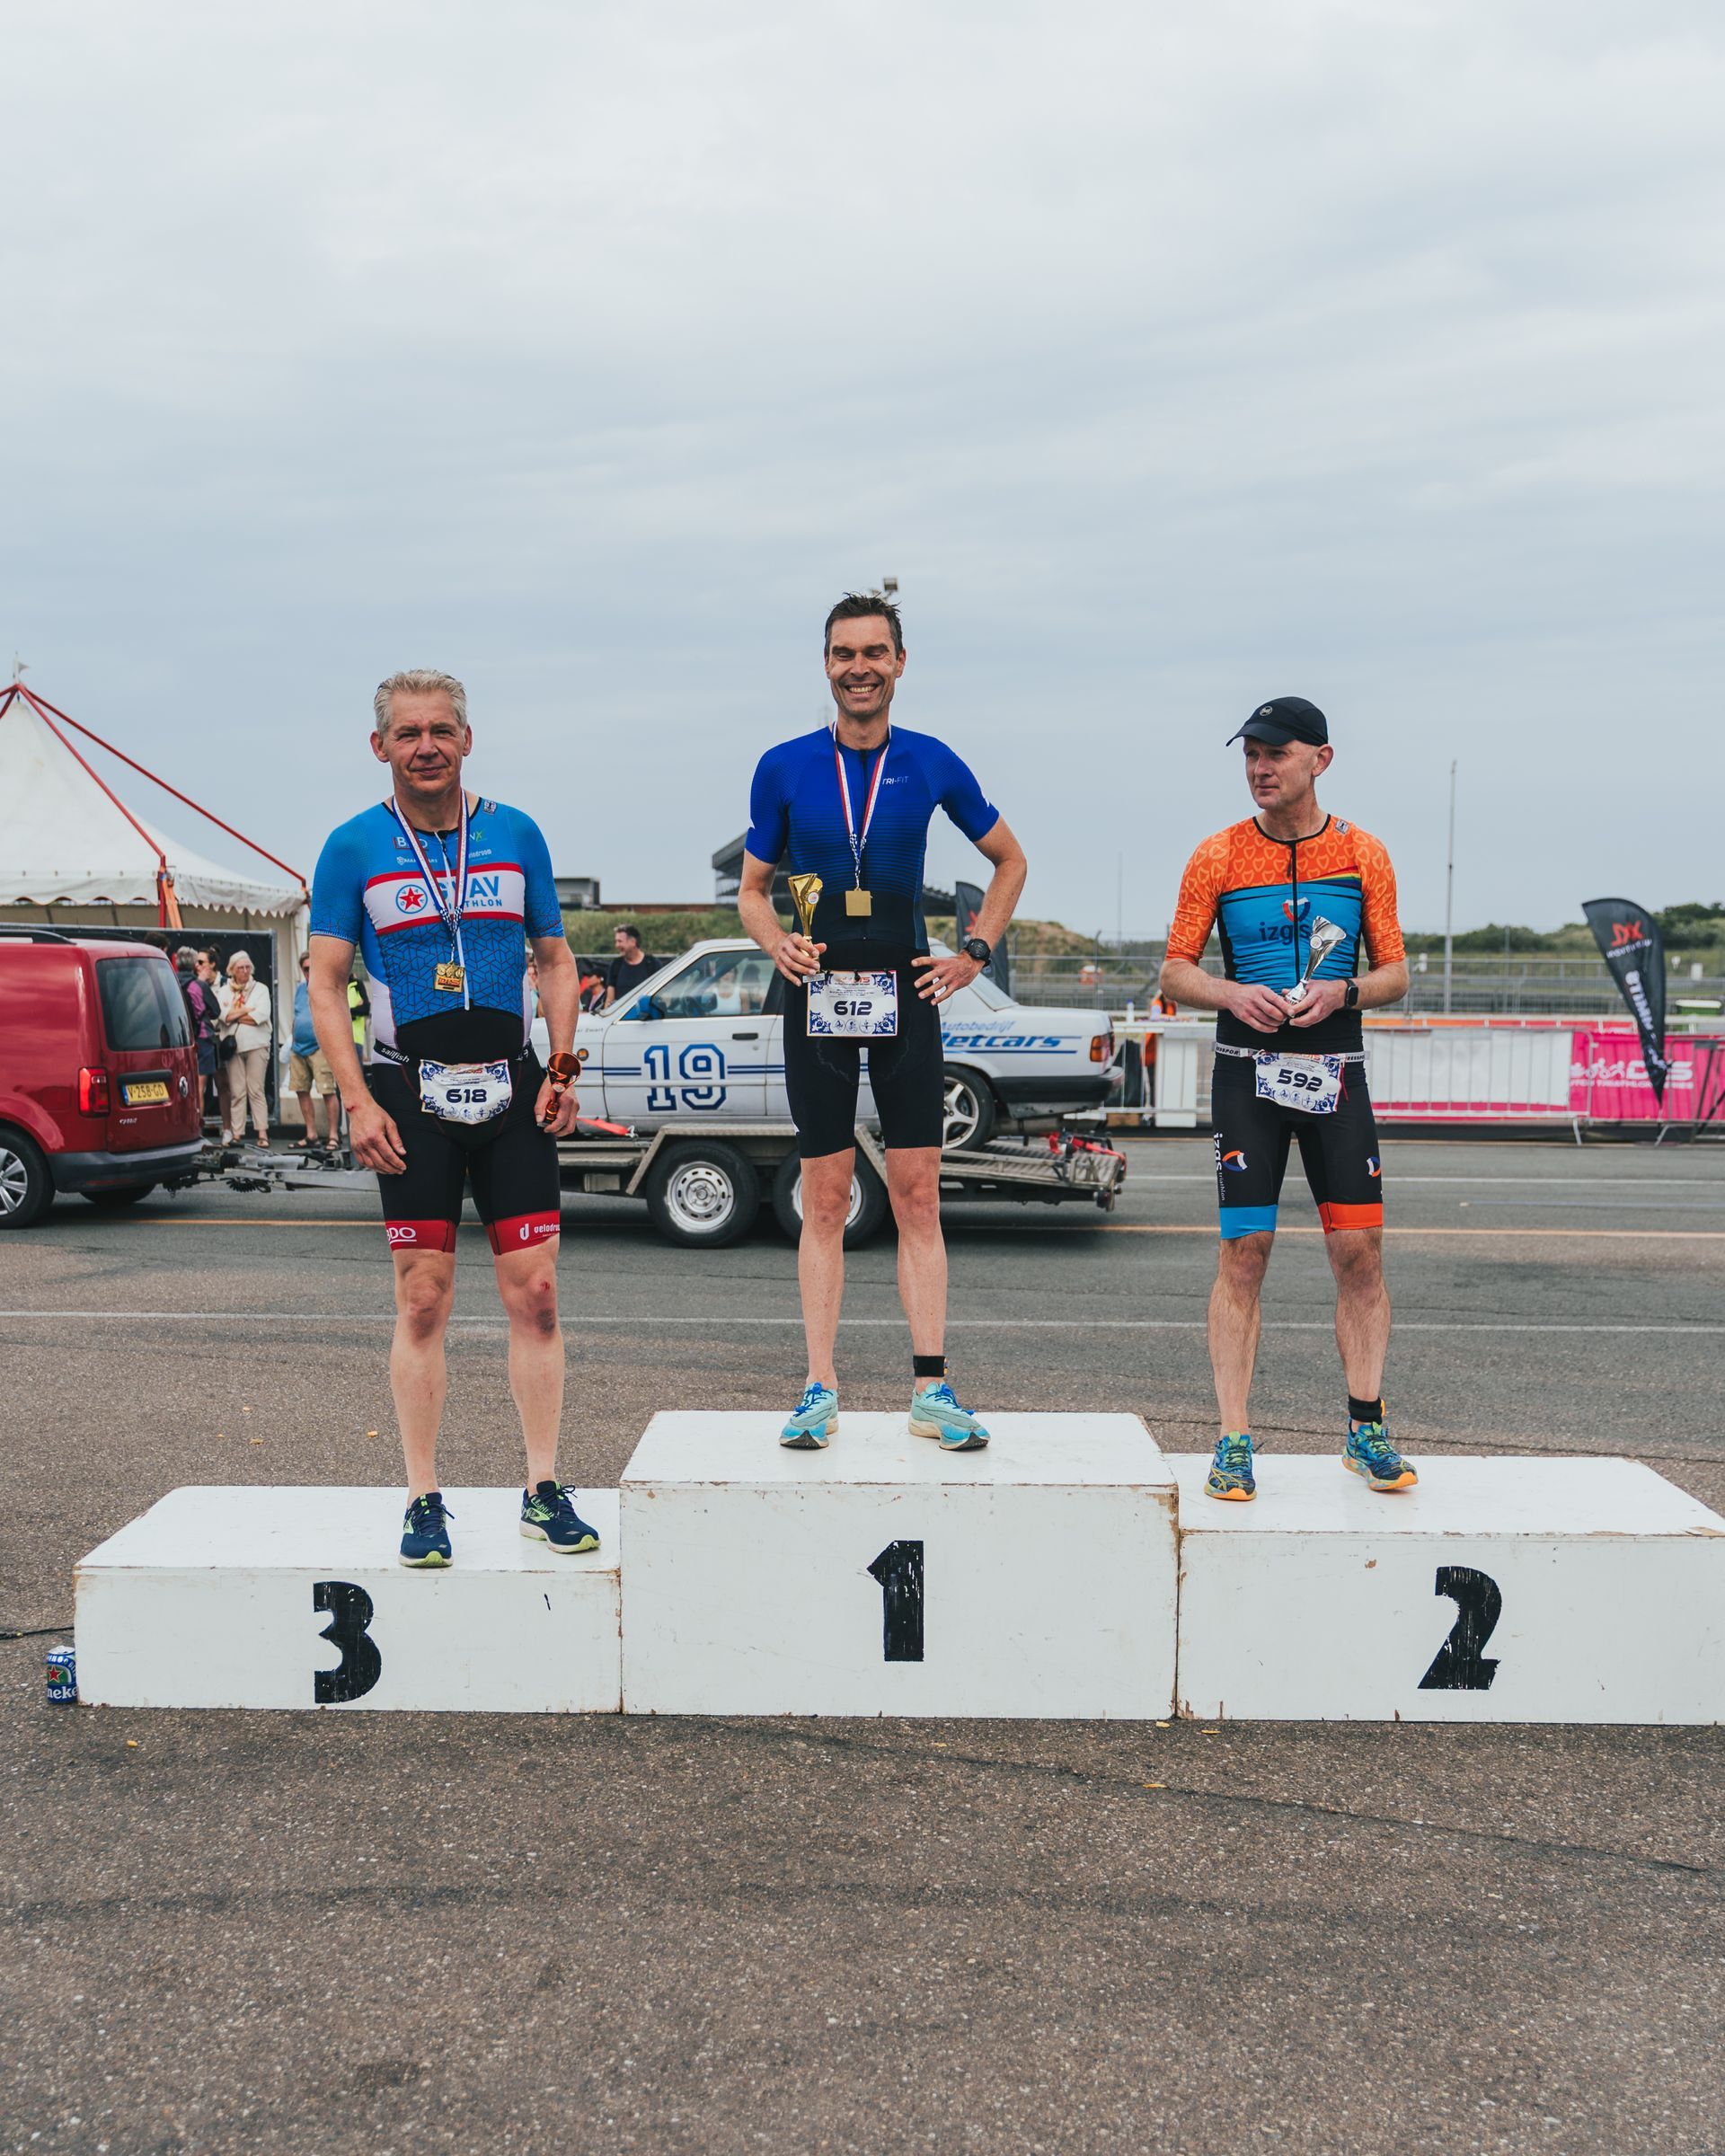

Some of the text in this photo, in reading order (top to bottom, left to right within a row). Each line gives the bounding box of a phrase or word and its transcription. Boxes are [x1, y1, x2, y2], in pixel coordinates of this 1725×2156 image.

[834, 1000, 872, 1016] 612
[381, 1047, 410, 1063] sailfish
[643, 1043, 727, 1112] 19
[446, 1088, 487, 1103] 618
[1277, 1068, 1323, 1092] 592
[867, 1540, 924, 1662] 1
[314, 1581, 382, 1704] 3
[1417, 1566, 1502, 1691] 2
